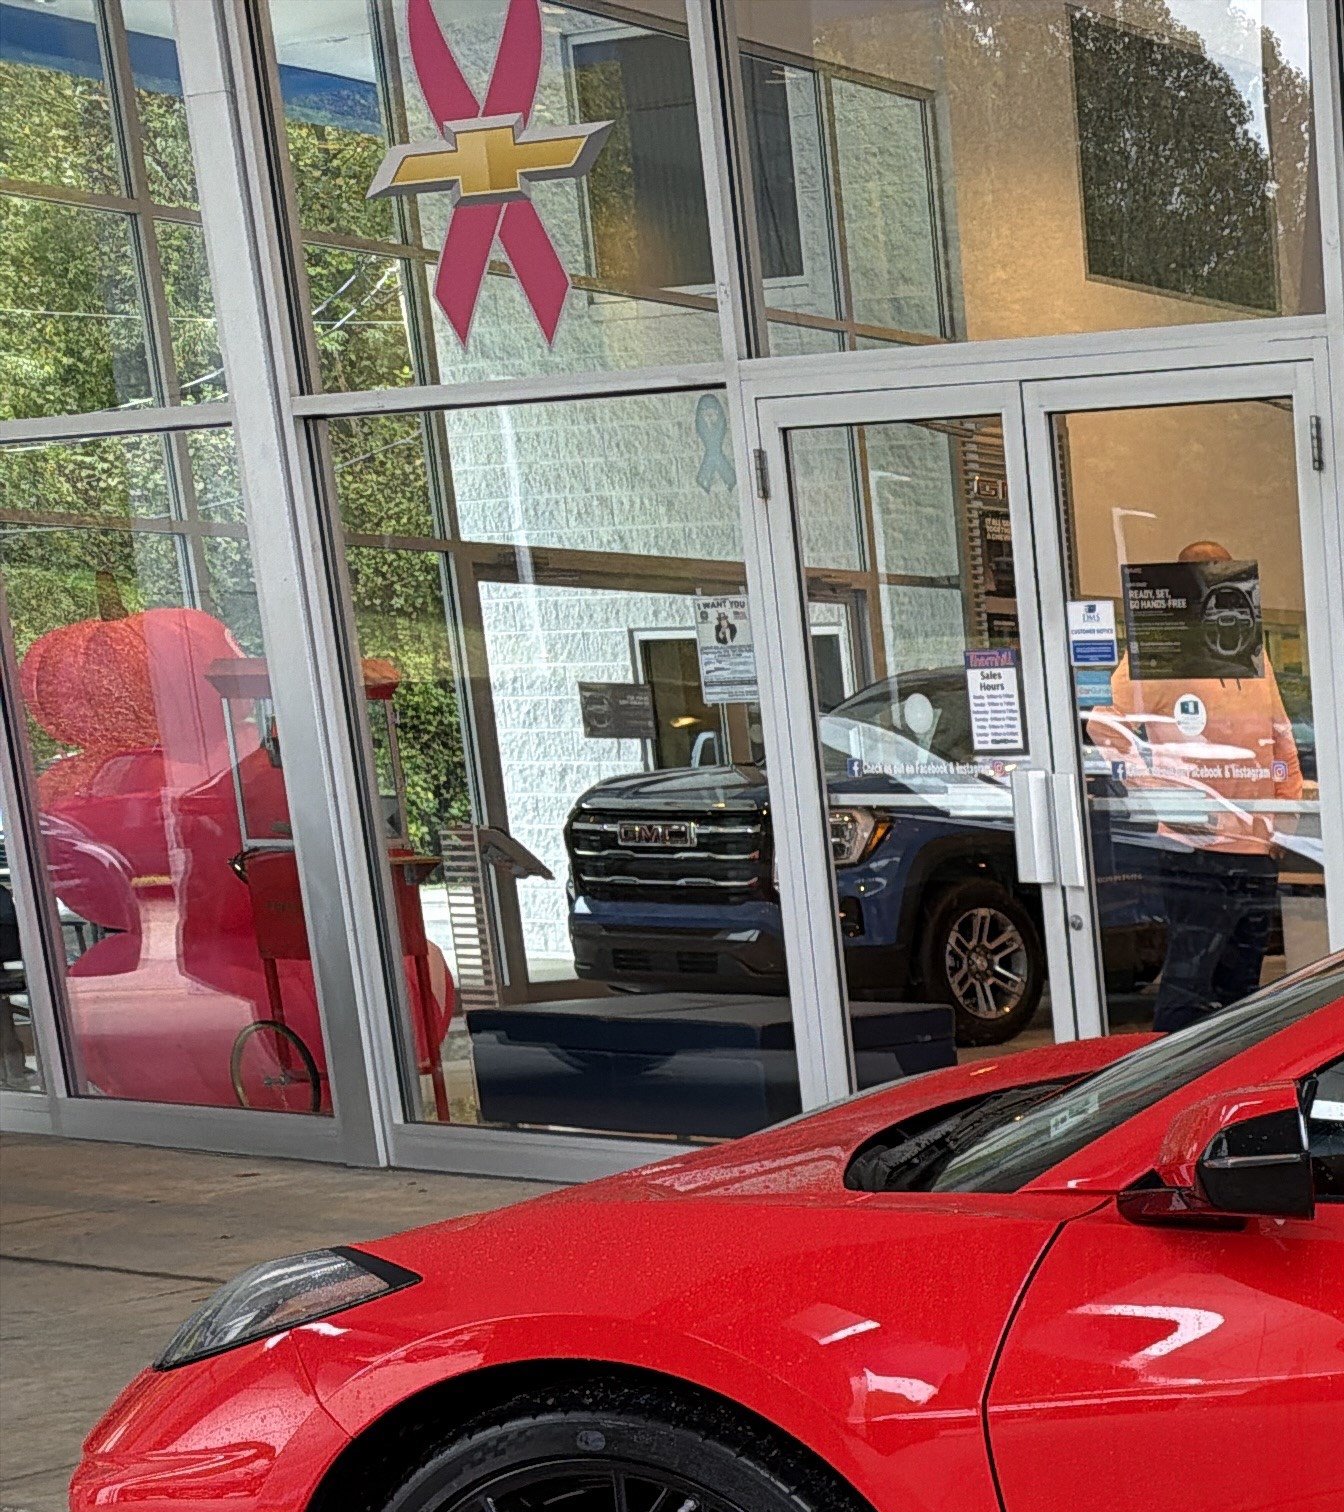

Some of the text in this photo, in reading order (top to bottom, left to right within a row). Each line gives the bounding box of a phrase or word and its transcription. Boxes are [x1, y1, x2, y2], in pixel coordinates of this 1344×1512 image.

[702, 600, 728, 610] WANT
[729, 600, 746, 609] YOU
[980, 671, 1002, 680] Sales
[980, 682, 1005, 691] Hours
